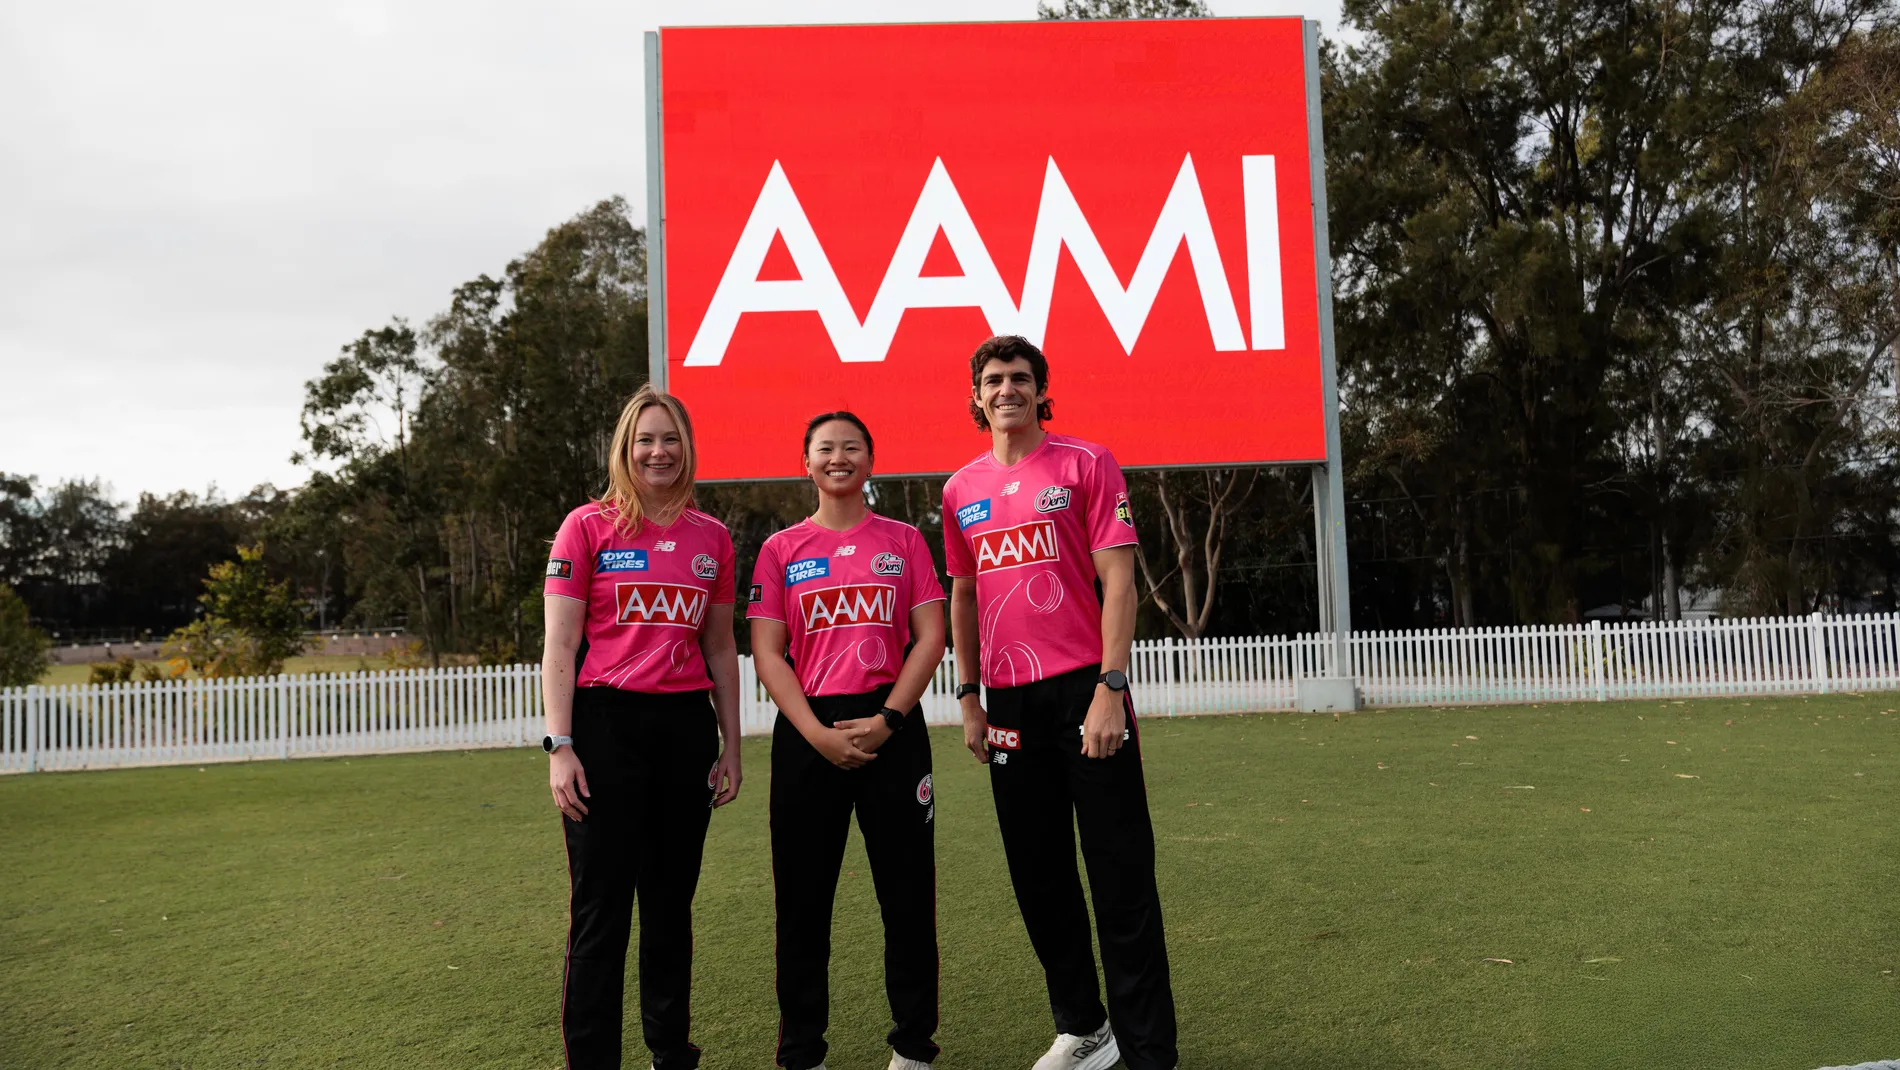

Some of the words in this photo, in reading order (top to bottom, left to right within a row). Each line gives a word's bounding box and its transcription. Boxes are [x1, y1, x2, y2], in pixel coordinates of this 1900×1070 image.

[683, 152, 1285, 366] AAMI
[958, 504, 981, 519] TOYO
[962, 510, 988, 527] TIRES
[601, 551, 635, 561] TOYO
[978, 525, 1055, 570] AAMI
[604, 559, 646, 569] TIRES
[789, 567, 826, 583] TIRES
[620, 586, 706, 625] AAMI
[807, 589, 892, 629] AAMI
[988, 727, 1018, 747] KFC
